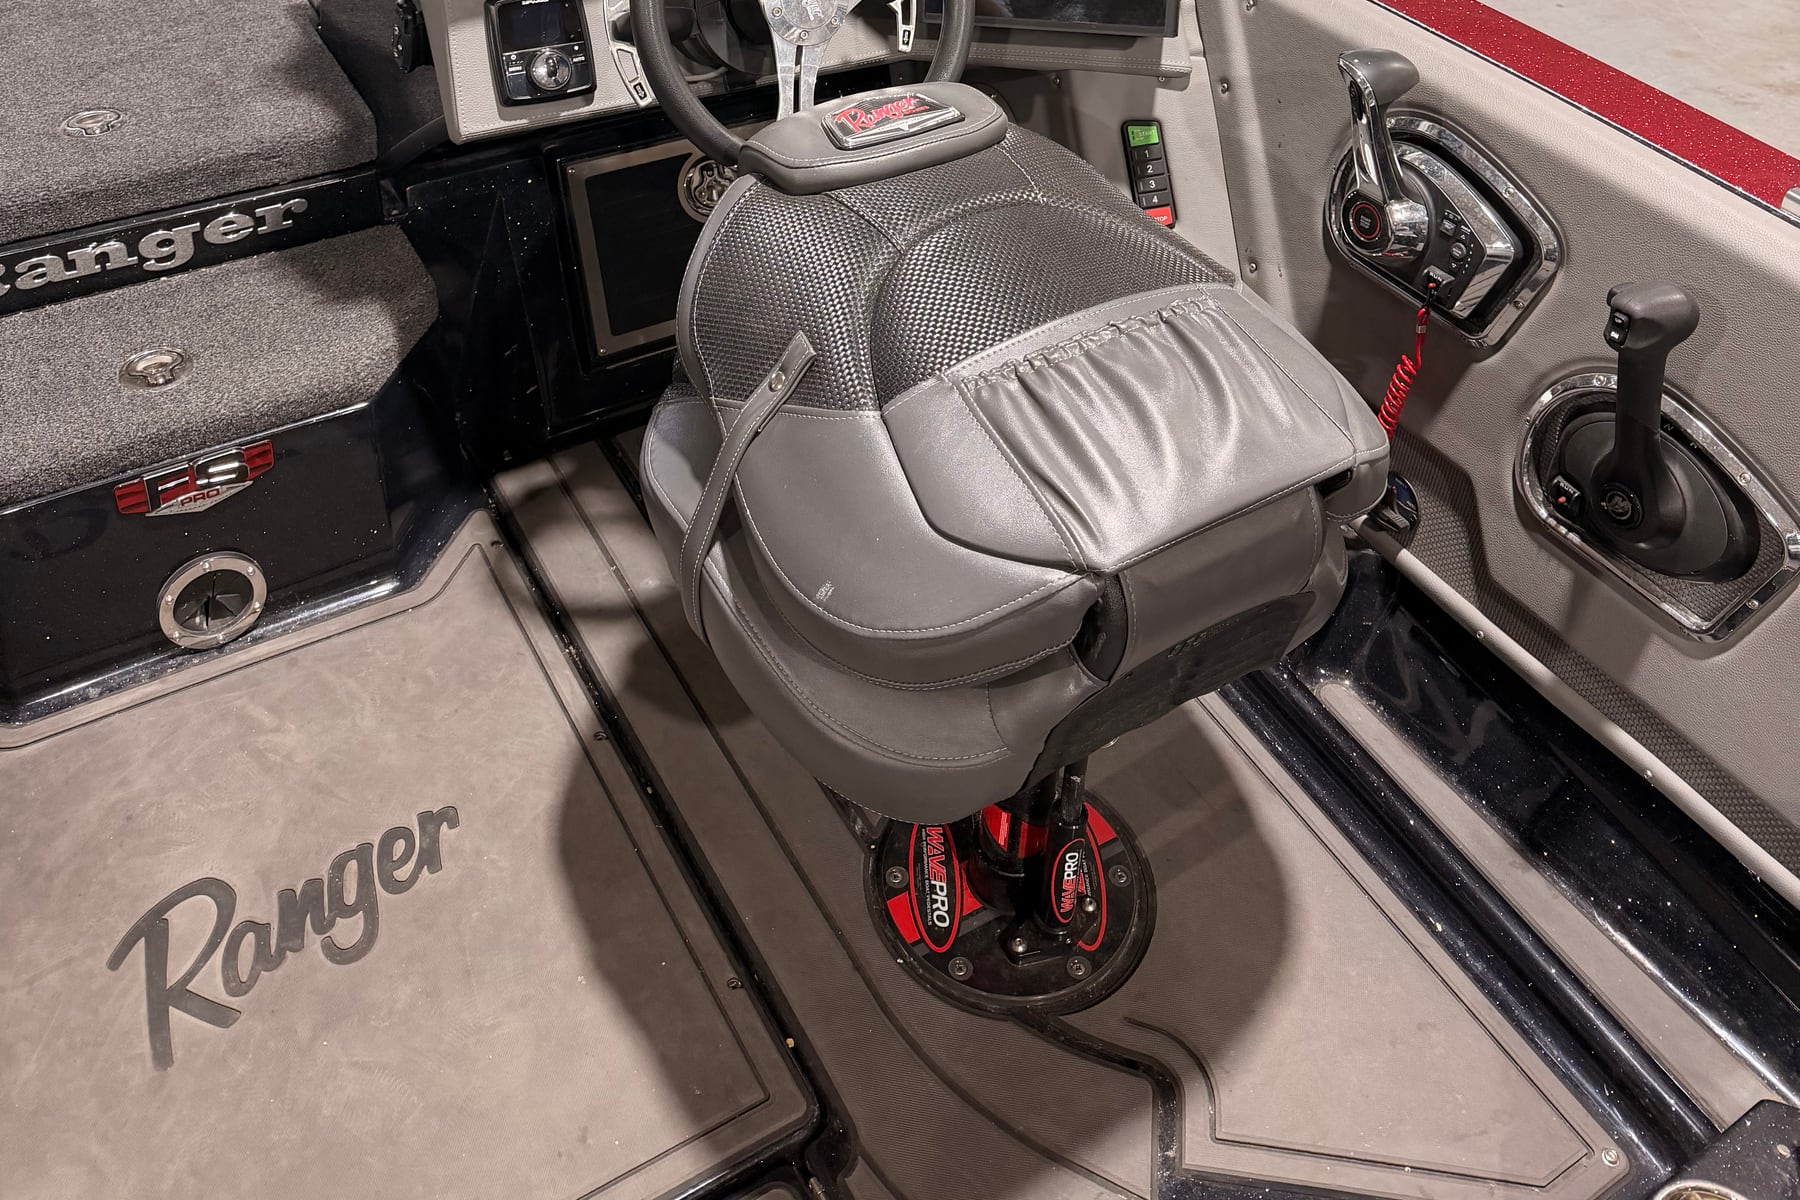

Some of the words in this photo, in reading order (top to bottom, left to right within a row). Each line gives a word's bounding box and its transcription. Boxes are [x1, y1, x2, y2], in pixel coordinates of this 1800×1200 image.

[834, 97, 920, 134] Ranger
[1144, 149, 1150, 158] 1
[1146, 164, 1154, 174] 2
[1148, 180, 1156, 189] 3
[0, 198, 309, 297] anger
[179, 488, 221, 507] PRO
[106, 805, 460, 1072] Ranger
